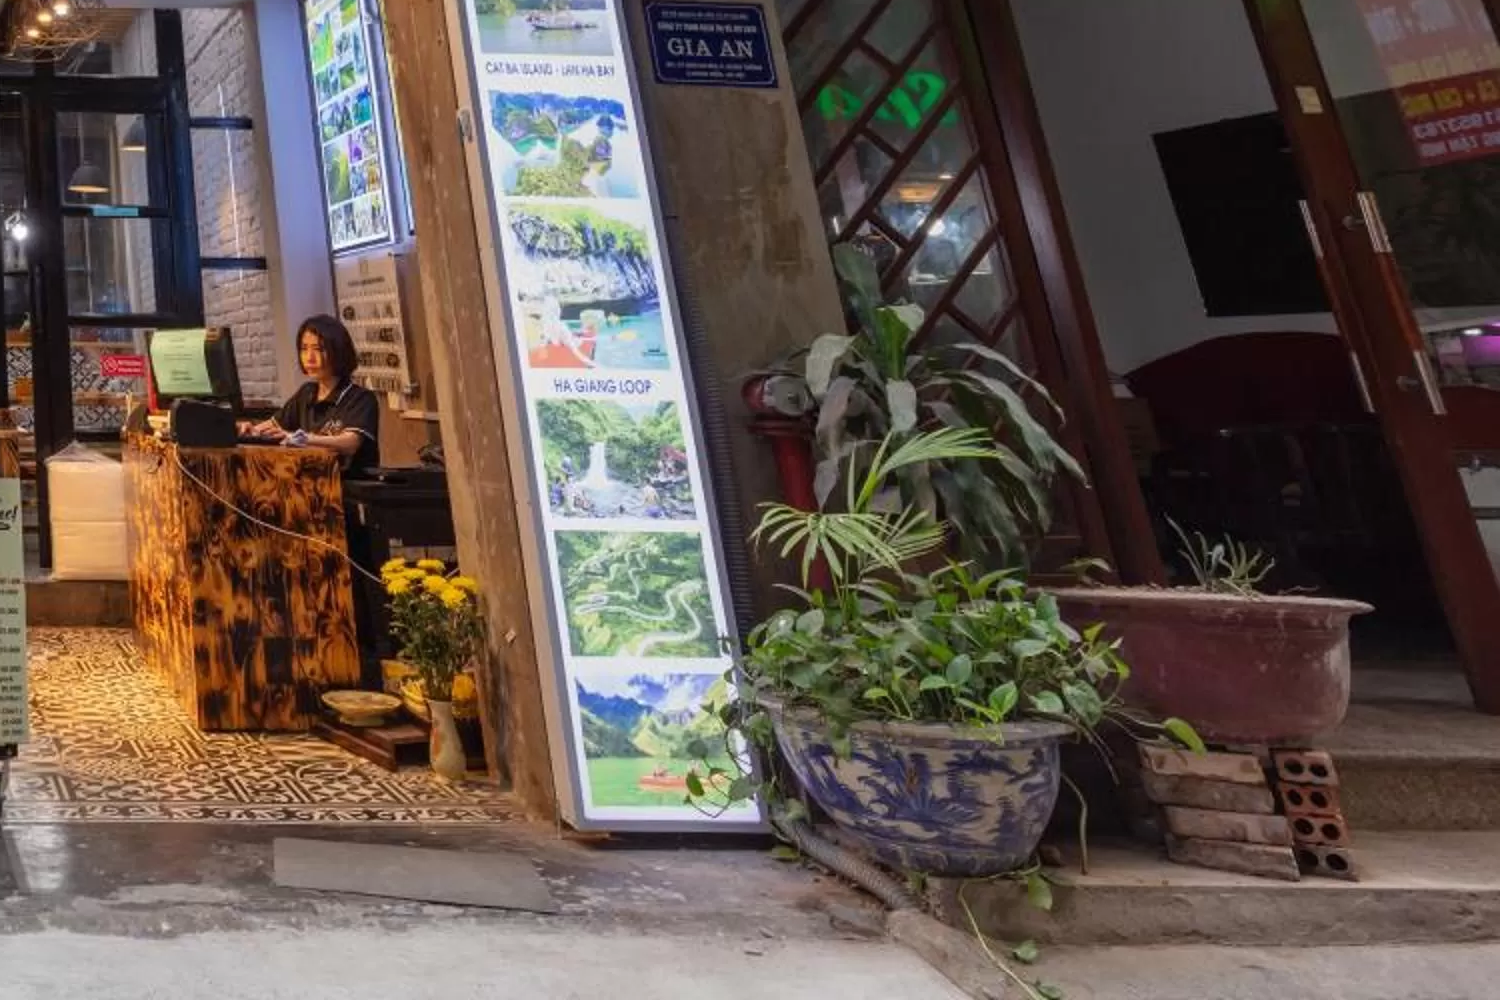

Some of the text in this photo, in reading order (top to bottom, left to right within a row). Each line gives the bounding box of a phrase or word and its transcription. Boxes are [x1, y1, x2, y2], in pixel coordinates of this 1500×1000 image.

[667, 37, 754, 59] GIA AN
[554, 378, 653, 394] HA GIANG LOOP
